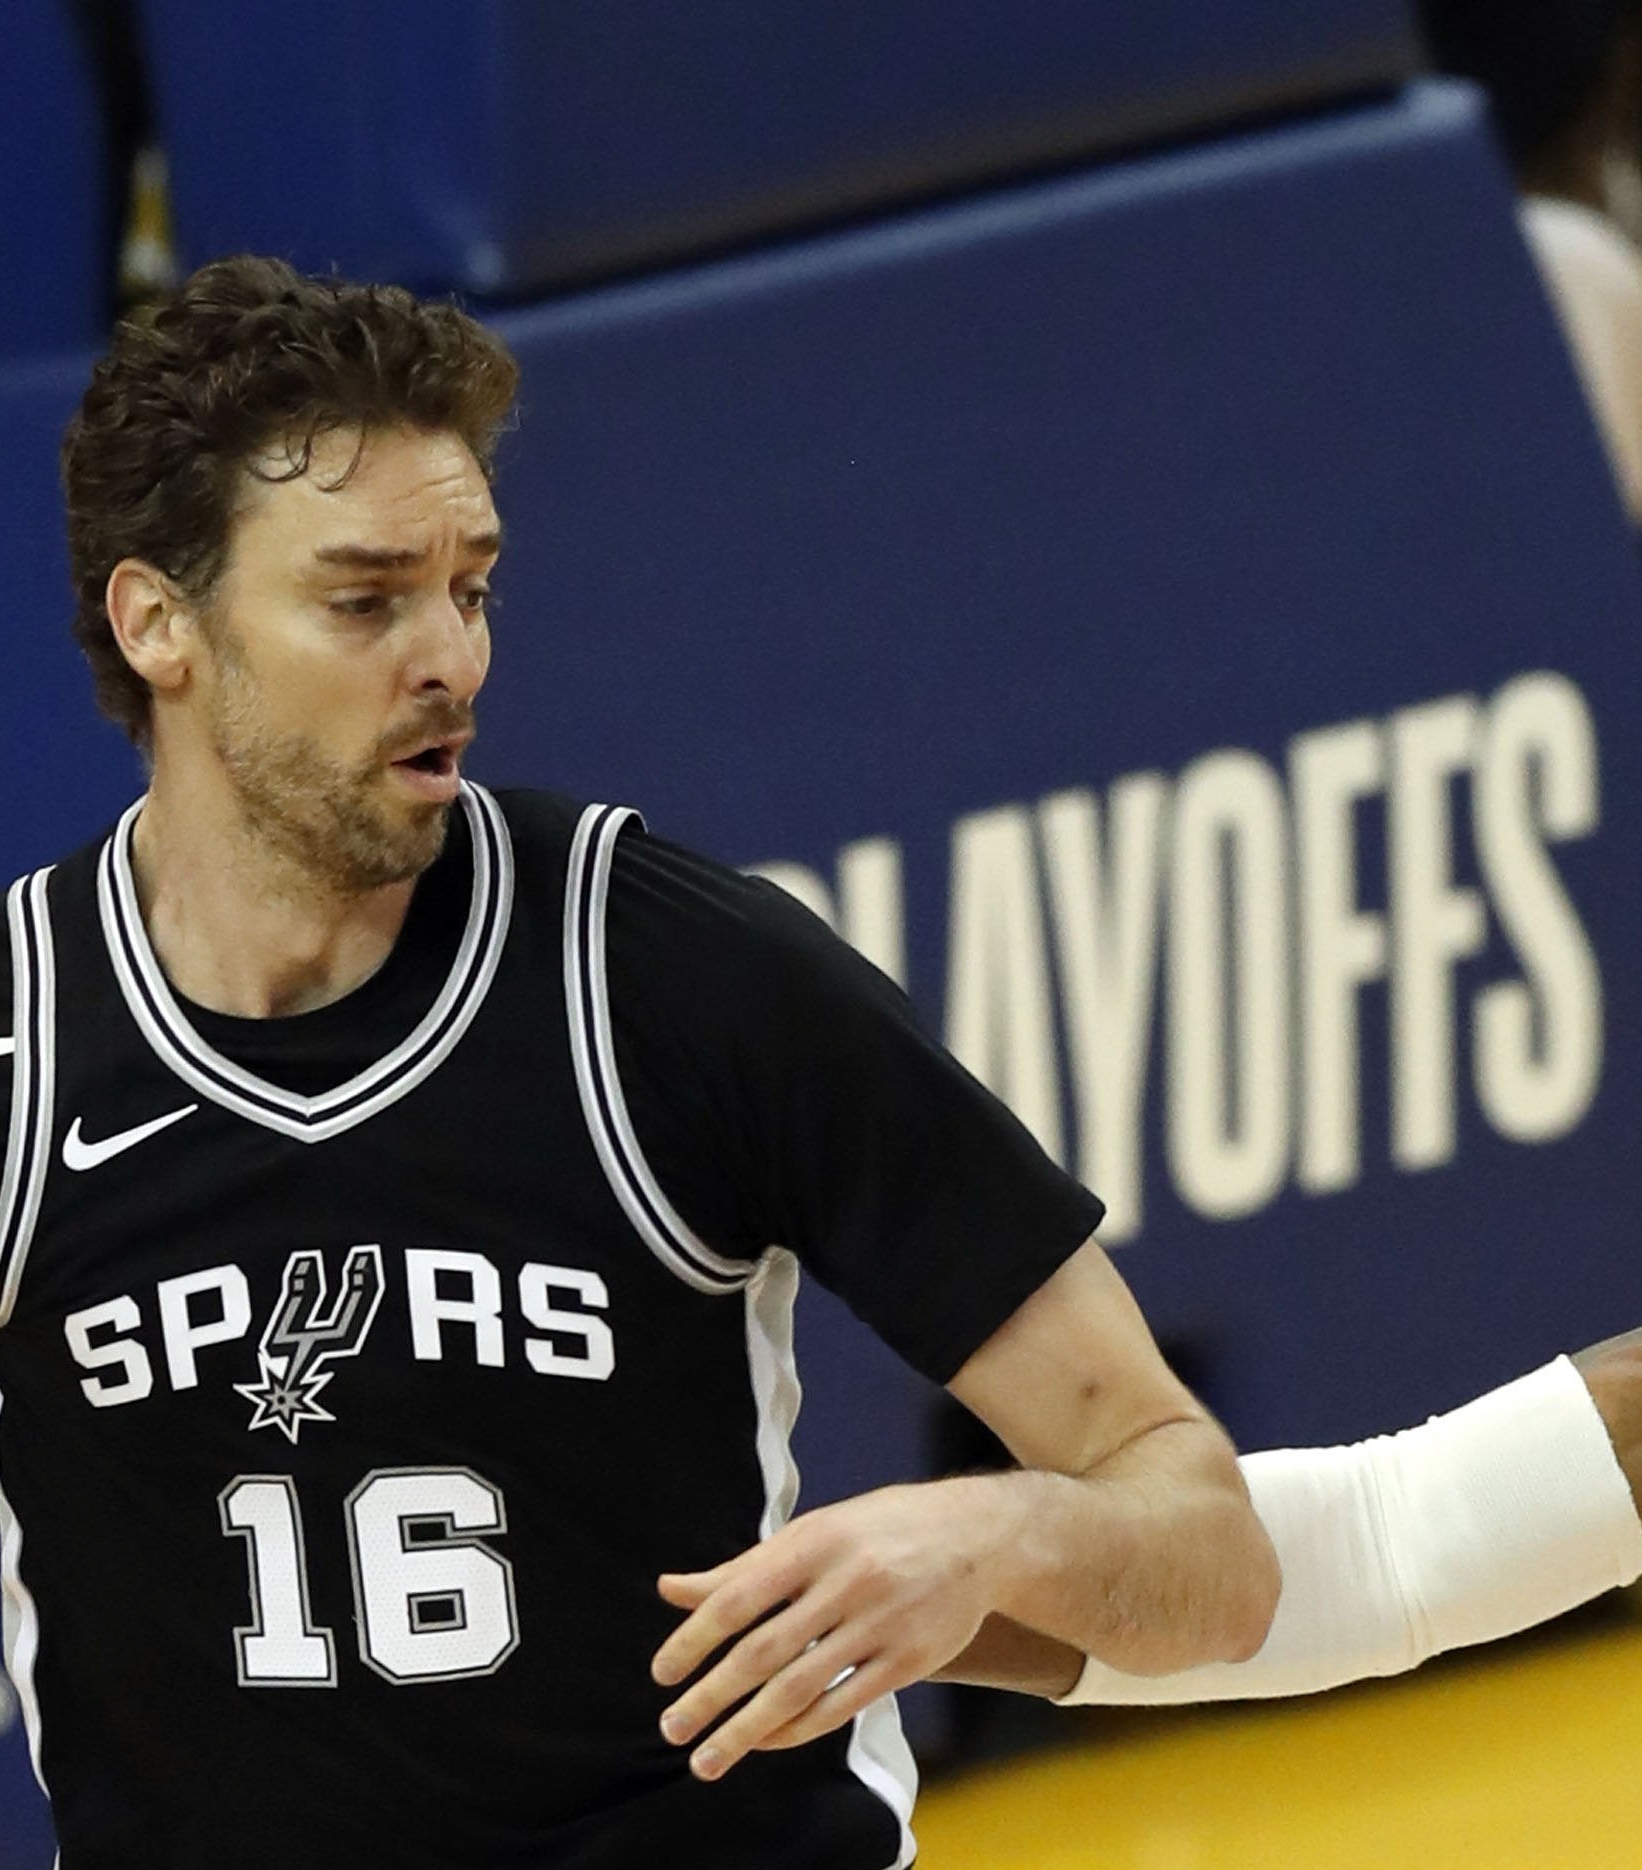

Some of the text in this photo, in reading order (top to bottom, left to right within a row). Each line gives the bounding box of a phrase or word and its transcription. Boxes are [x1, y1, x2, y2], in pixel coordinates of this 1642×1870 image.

[741, 668, 1605, 1246] AYOFFS
[63, 1244, 615, 1443] SPURS
[217, 1466, 520, 1687] 16
